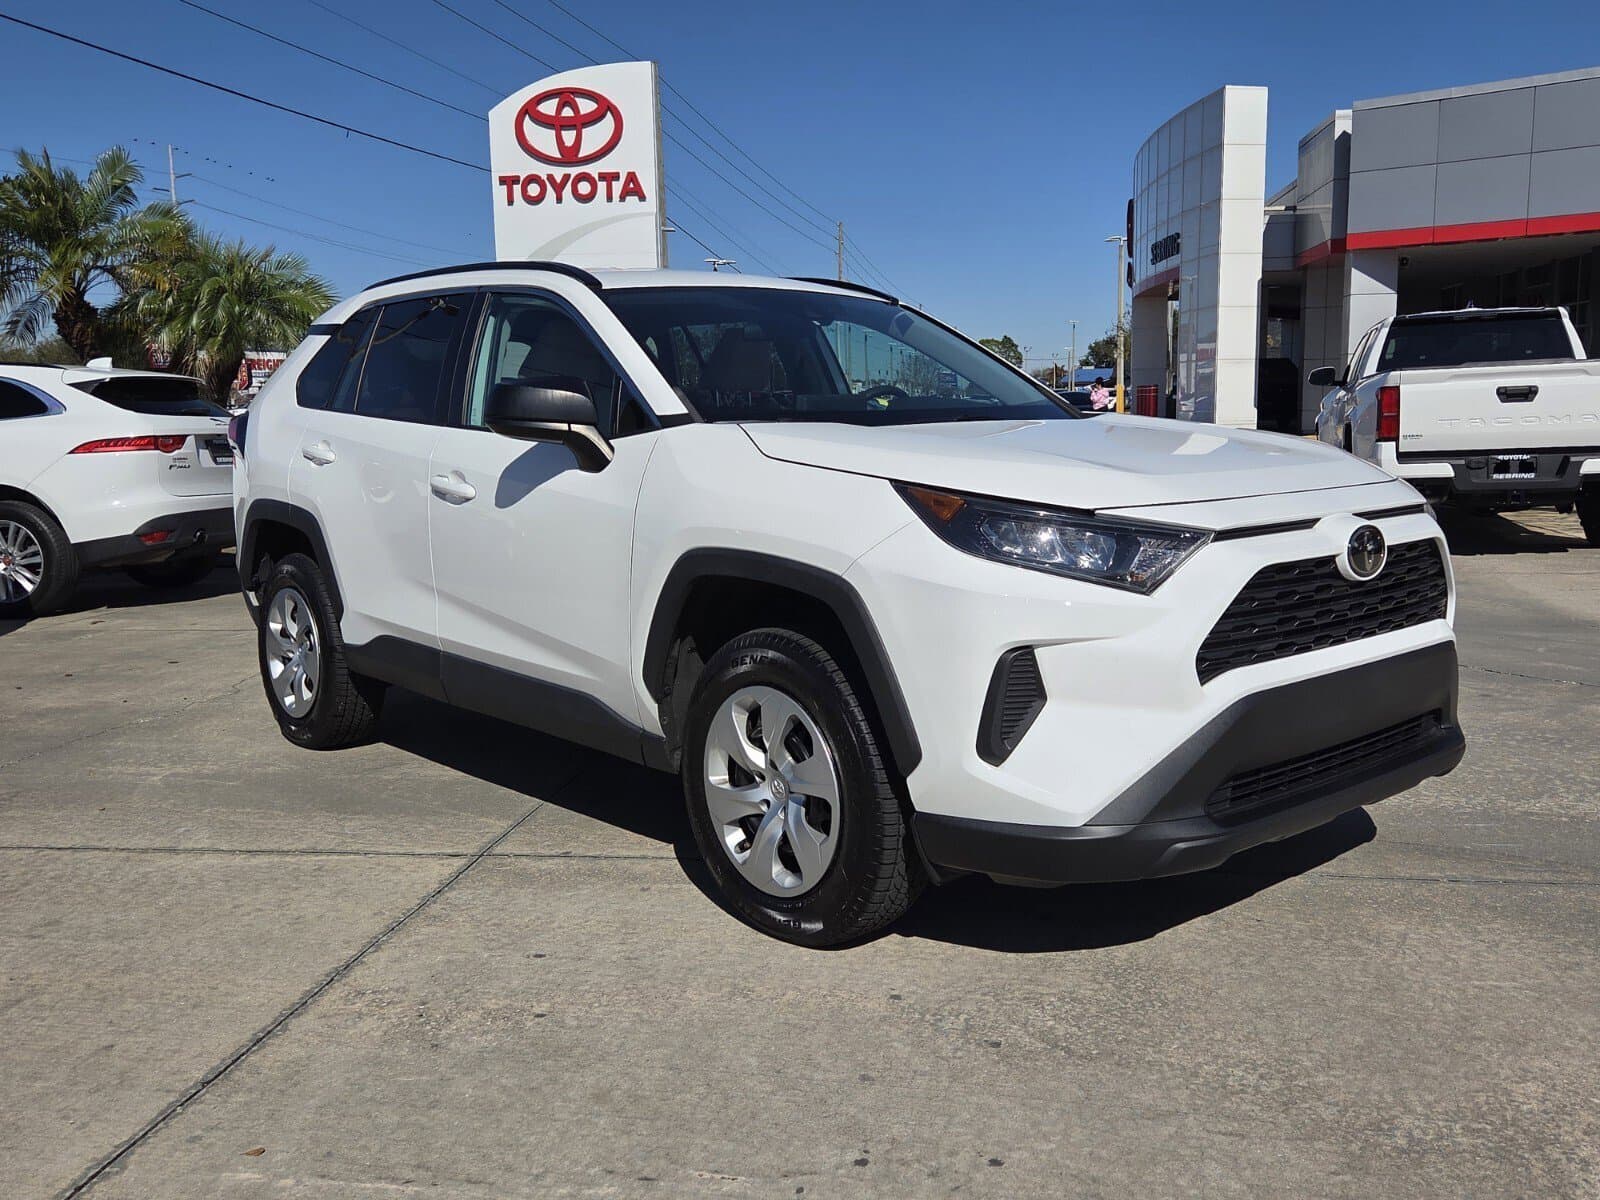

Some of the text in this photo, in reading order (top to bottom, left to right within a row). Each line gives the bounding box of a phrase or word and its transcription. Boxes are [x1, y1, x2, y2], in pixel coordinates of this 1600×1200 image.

[499, 171, 646, 206] TOYOTA
[1437, 413, 1600, 429] TACOMA
[1492, 472, 1536, 480] SEBRING
